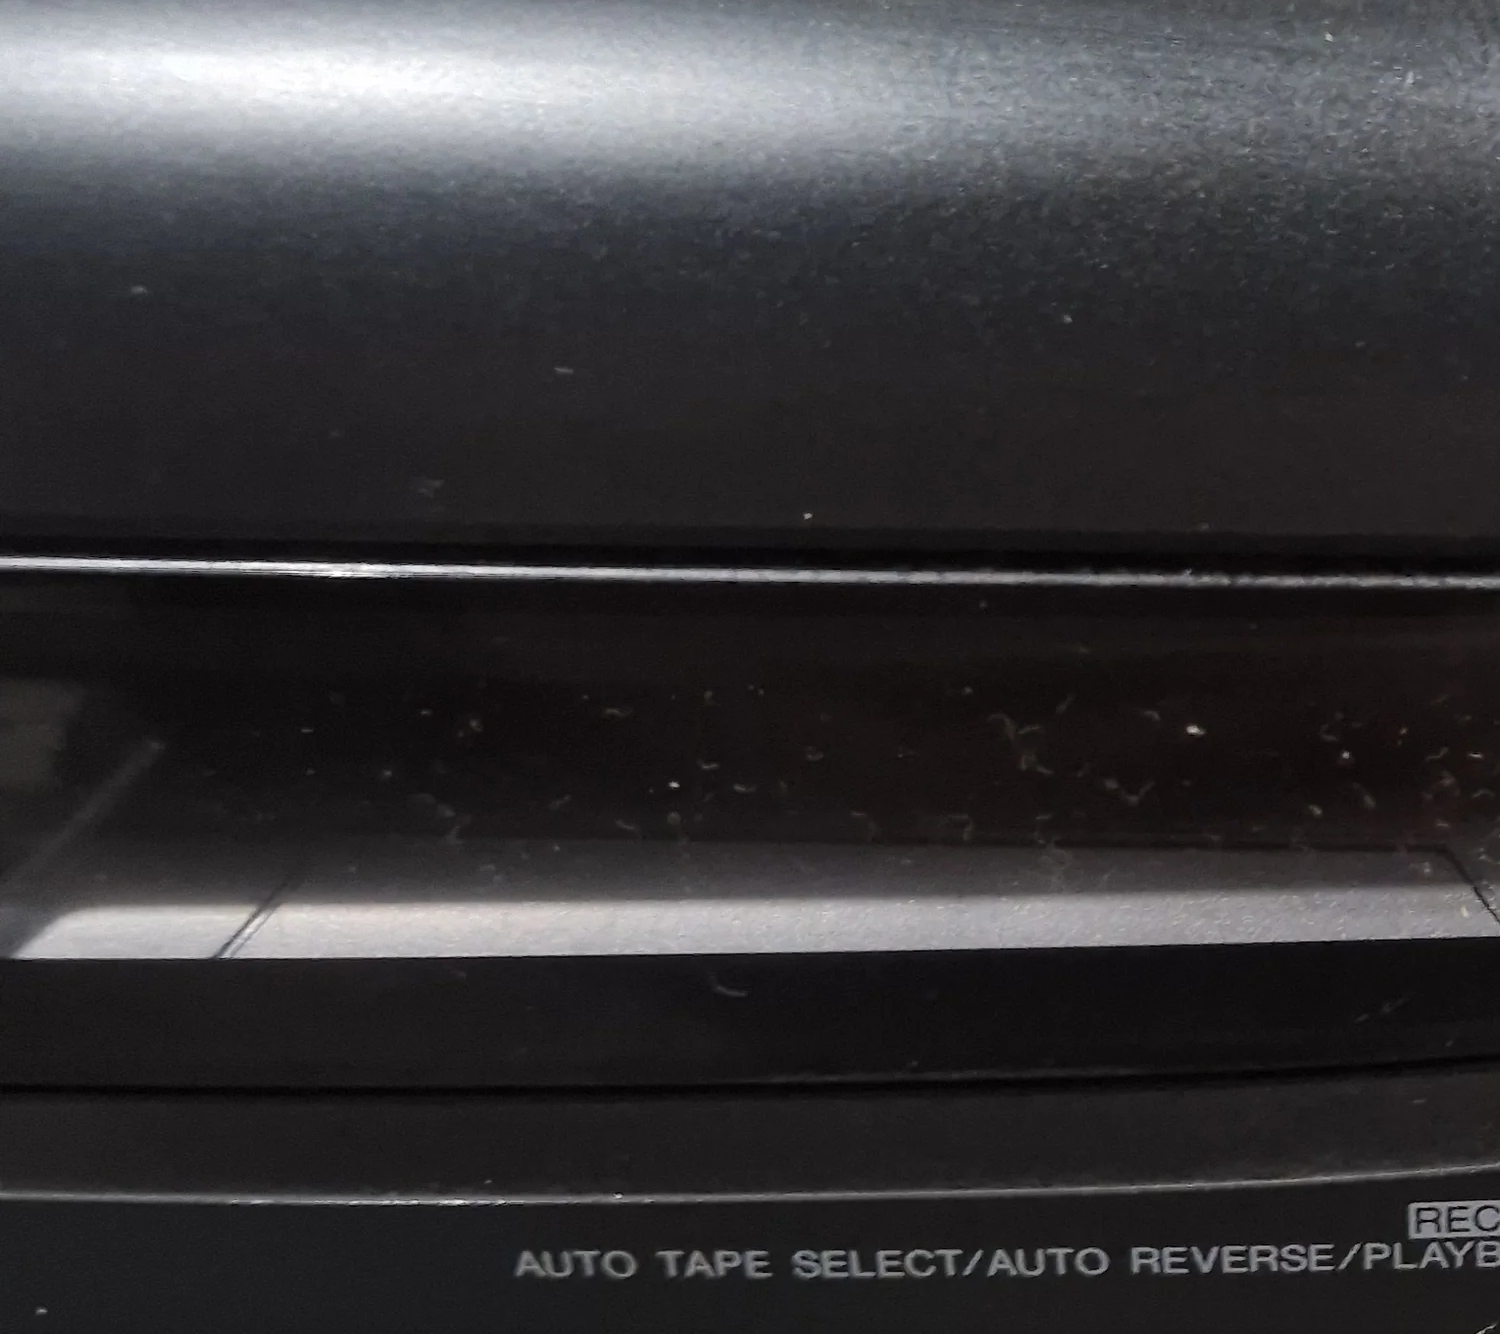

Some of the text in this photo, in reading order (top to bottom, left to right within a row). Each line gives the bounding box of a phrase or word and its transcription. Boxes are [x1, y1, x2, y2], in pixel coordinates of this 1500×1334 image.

[514, 1249, 637, 1280] AUTO
[655, 1249, 773, 1279] TAPE
[792, 1246, 1110, 1279] SELECT/AUTO
